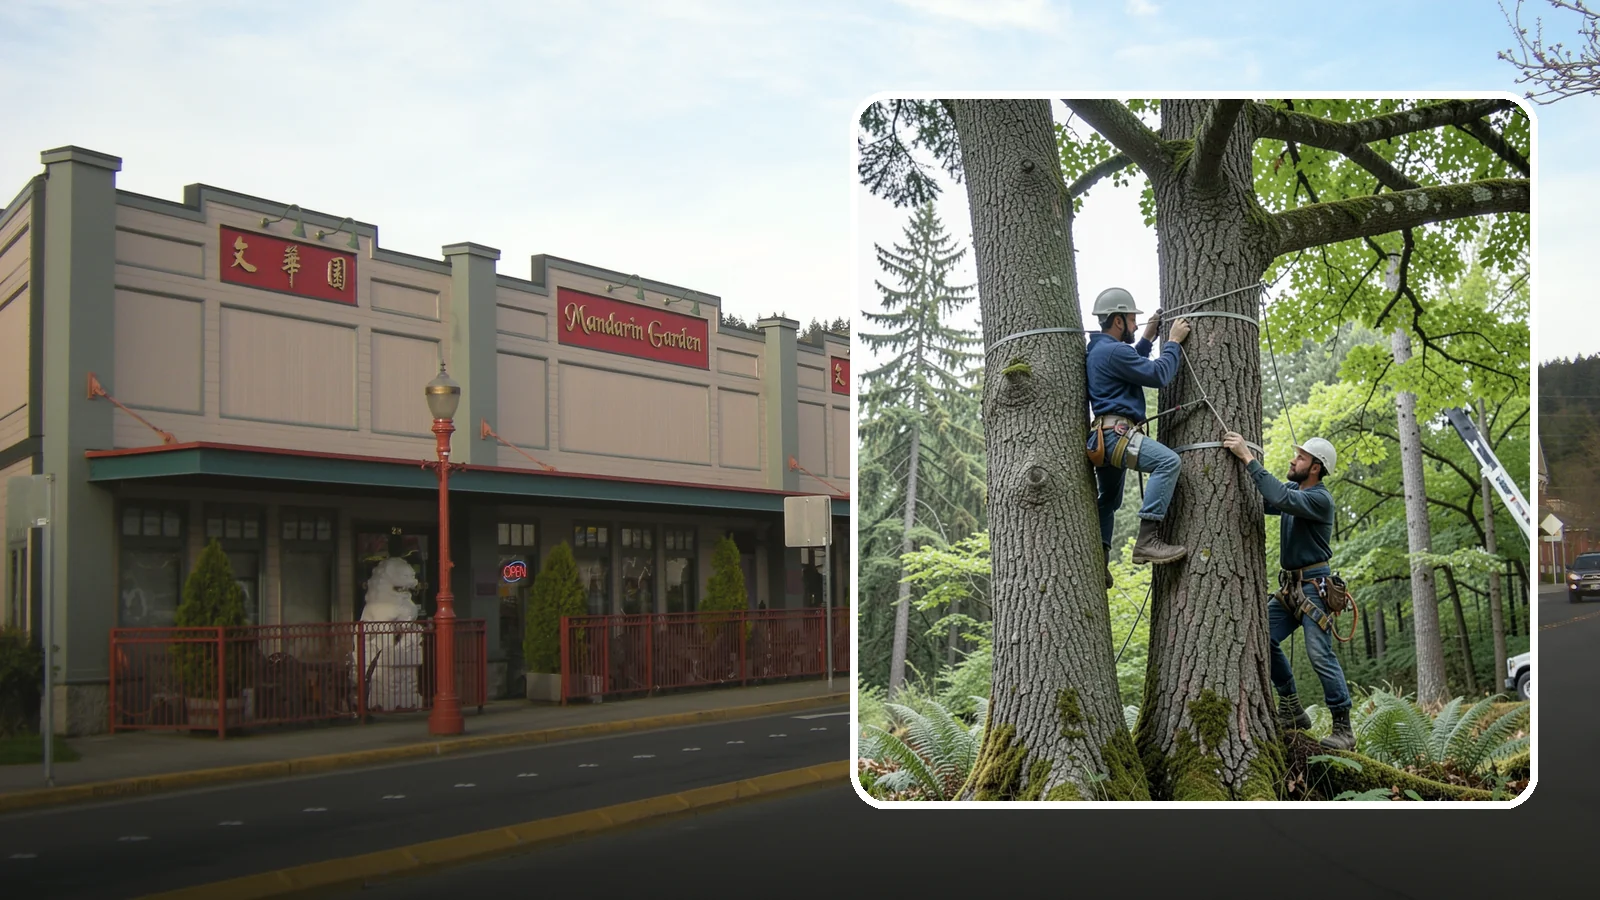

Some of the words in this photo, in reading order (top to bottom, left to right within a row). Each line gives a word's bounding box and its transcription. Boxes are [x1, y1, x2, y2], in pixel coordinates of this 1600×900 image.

[230, 235, 346, 291] 文華園
[564, 302, 644, 341] Mandarin
[647, 320, 702, 352] Garden
[503, 565, 527, 579] OPEN
